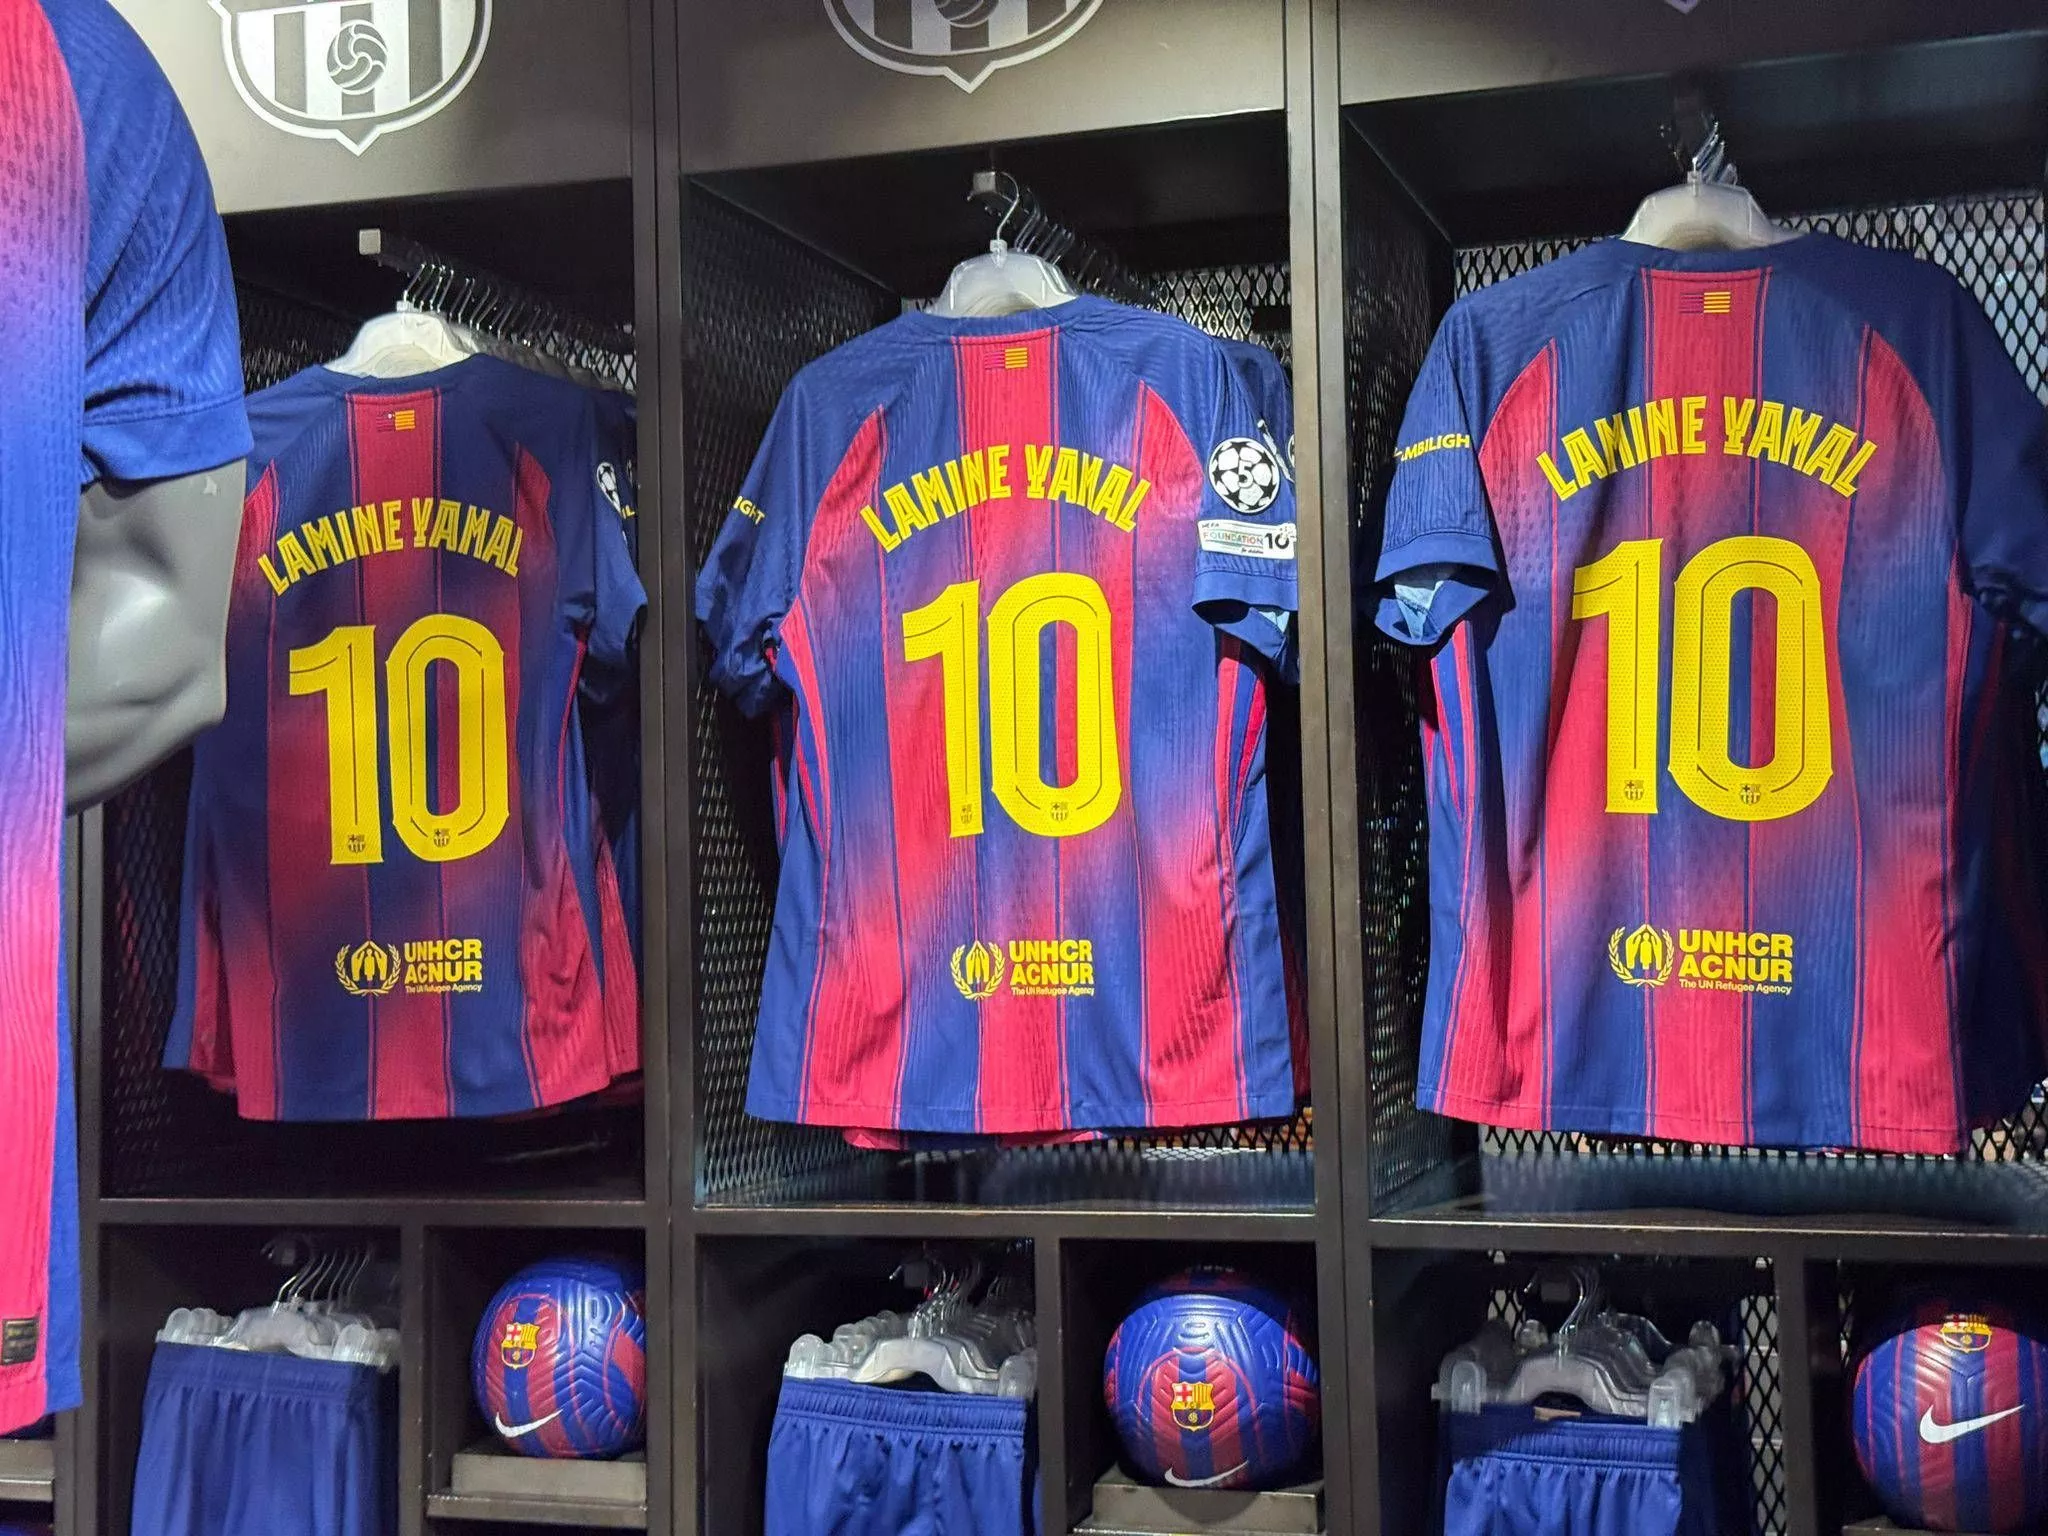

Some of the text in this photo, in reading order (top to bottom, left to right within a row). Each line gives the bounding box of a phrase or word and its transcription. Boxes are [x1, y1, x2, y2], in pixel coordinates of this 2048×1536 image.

[1536, 396, 1878, 501] LAMINE YAMAL
[860, 444, 1151, 553] LAMINE YAMAL
[257, 497, 524, 597] LAMINE YAMAL
[1203, 531, 1264, 546] FOUNDATION
[1573, 536, 1833, 821] 10
[902, 573, 1123, 838] 10
[288, 614, 510, 864] 10
[404, 938, 483, 963] UNHCR
[1009, 939, 1093, 962] UNHCR
[1679, 928, 1793, 958] UNHCR
[404, 960, 483, 984] ACNUR
[1010, 961, 1094, 986] ACNUR
[1678, 953, 1793, 983] ACNUR
[452, 983, 482, 993] Agency
[1011, 987, 1026, 996] The
[1036, 986, 1067, 997] Refugee
[1068, 985, 1095, 997] Agency
[1679, 978, 1792, 995] The UN Refugee Agency
